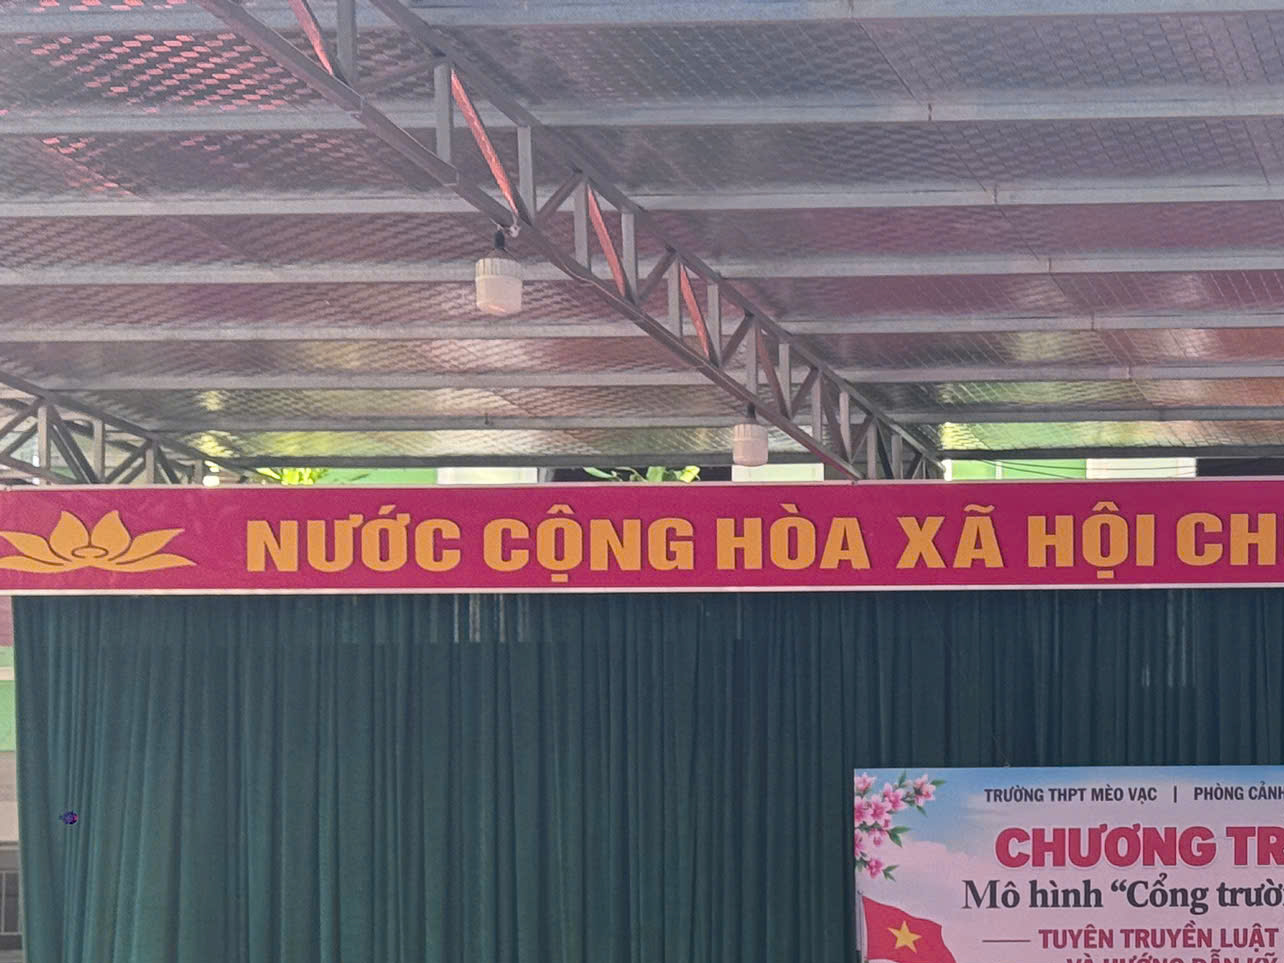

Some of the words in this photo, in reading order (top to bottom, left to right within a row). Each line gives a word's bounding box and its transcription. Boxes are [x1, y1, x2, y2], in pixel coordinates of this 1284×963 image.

[246, 503, 461, 572] NƯỚC
[483, 503, 694, 583] CỘNG
[716, 502, 868, 570] HÒA
[897, 504, 1003, 569] XÃ
[1027, 501, 1155, 582] HỘI
[984, 785, 1043, 802] TRƯỜNG
[1048, 788, 1086, 802] THPT
[1091, 784, 1124, 801] MÈO
[1128, 787, 1157, 804] VẠC
[1194, 783, 1244, 800] PHÒNG
[995, 823, 1217, 868] CHƯƠNG
[962, 880, 1020, 909] Mô
[1029, 880, 1103, 908] hình
[1111, 873, 1209, 915] “Cổng
[1038, 924, 1114, 949] TUYÊN
[1120, 920, 1212, 948] TRUYỀN
[1220, 923, 1279, 952] LUẬT
